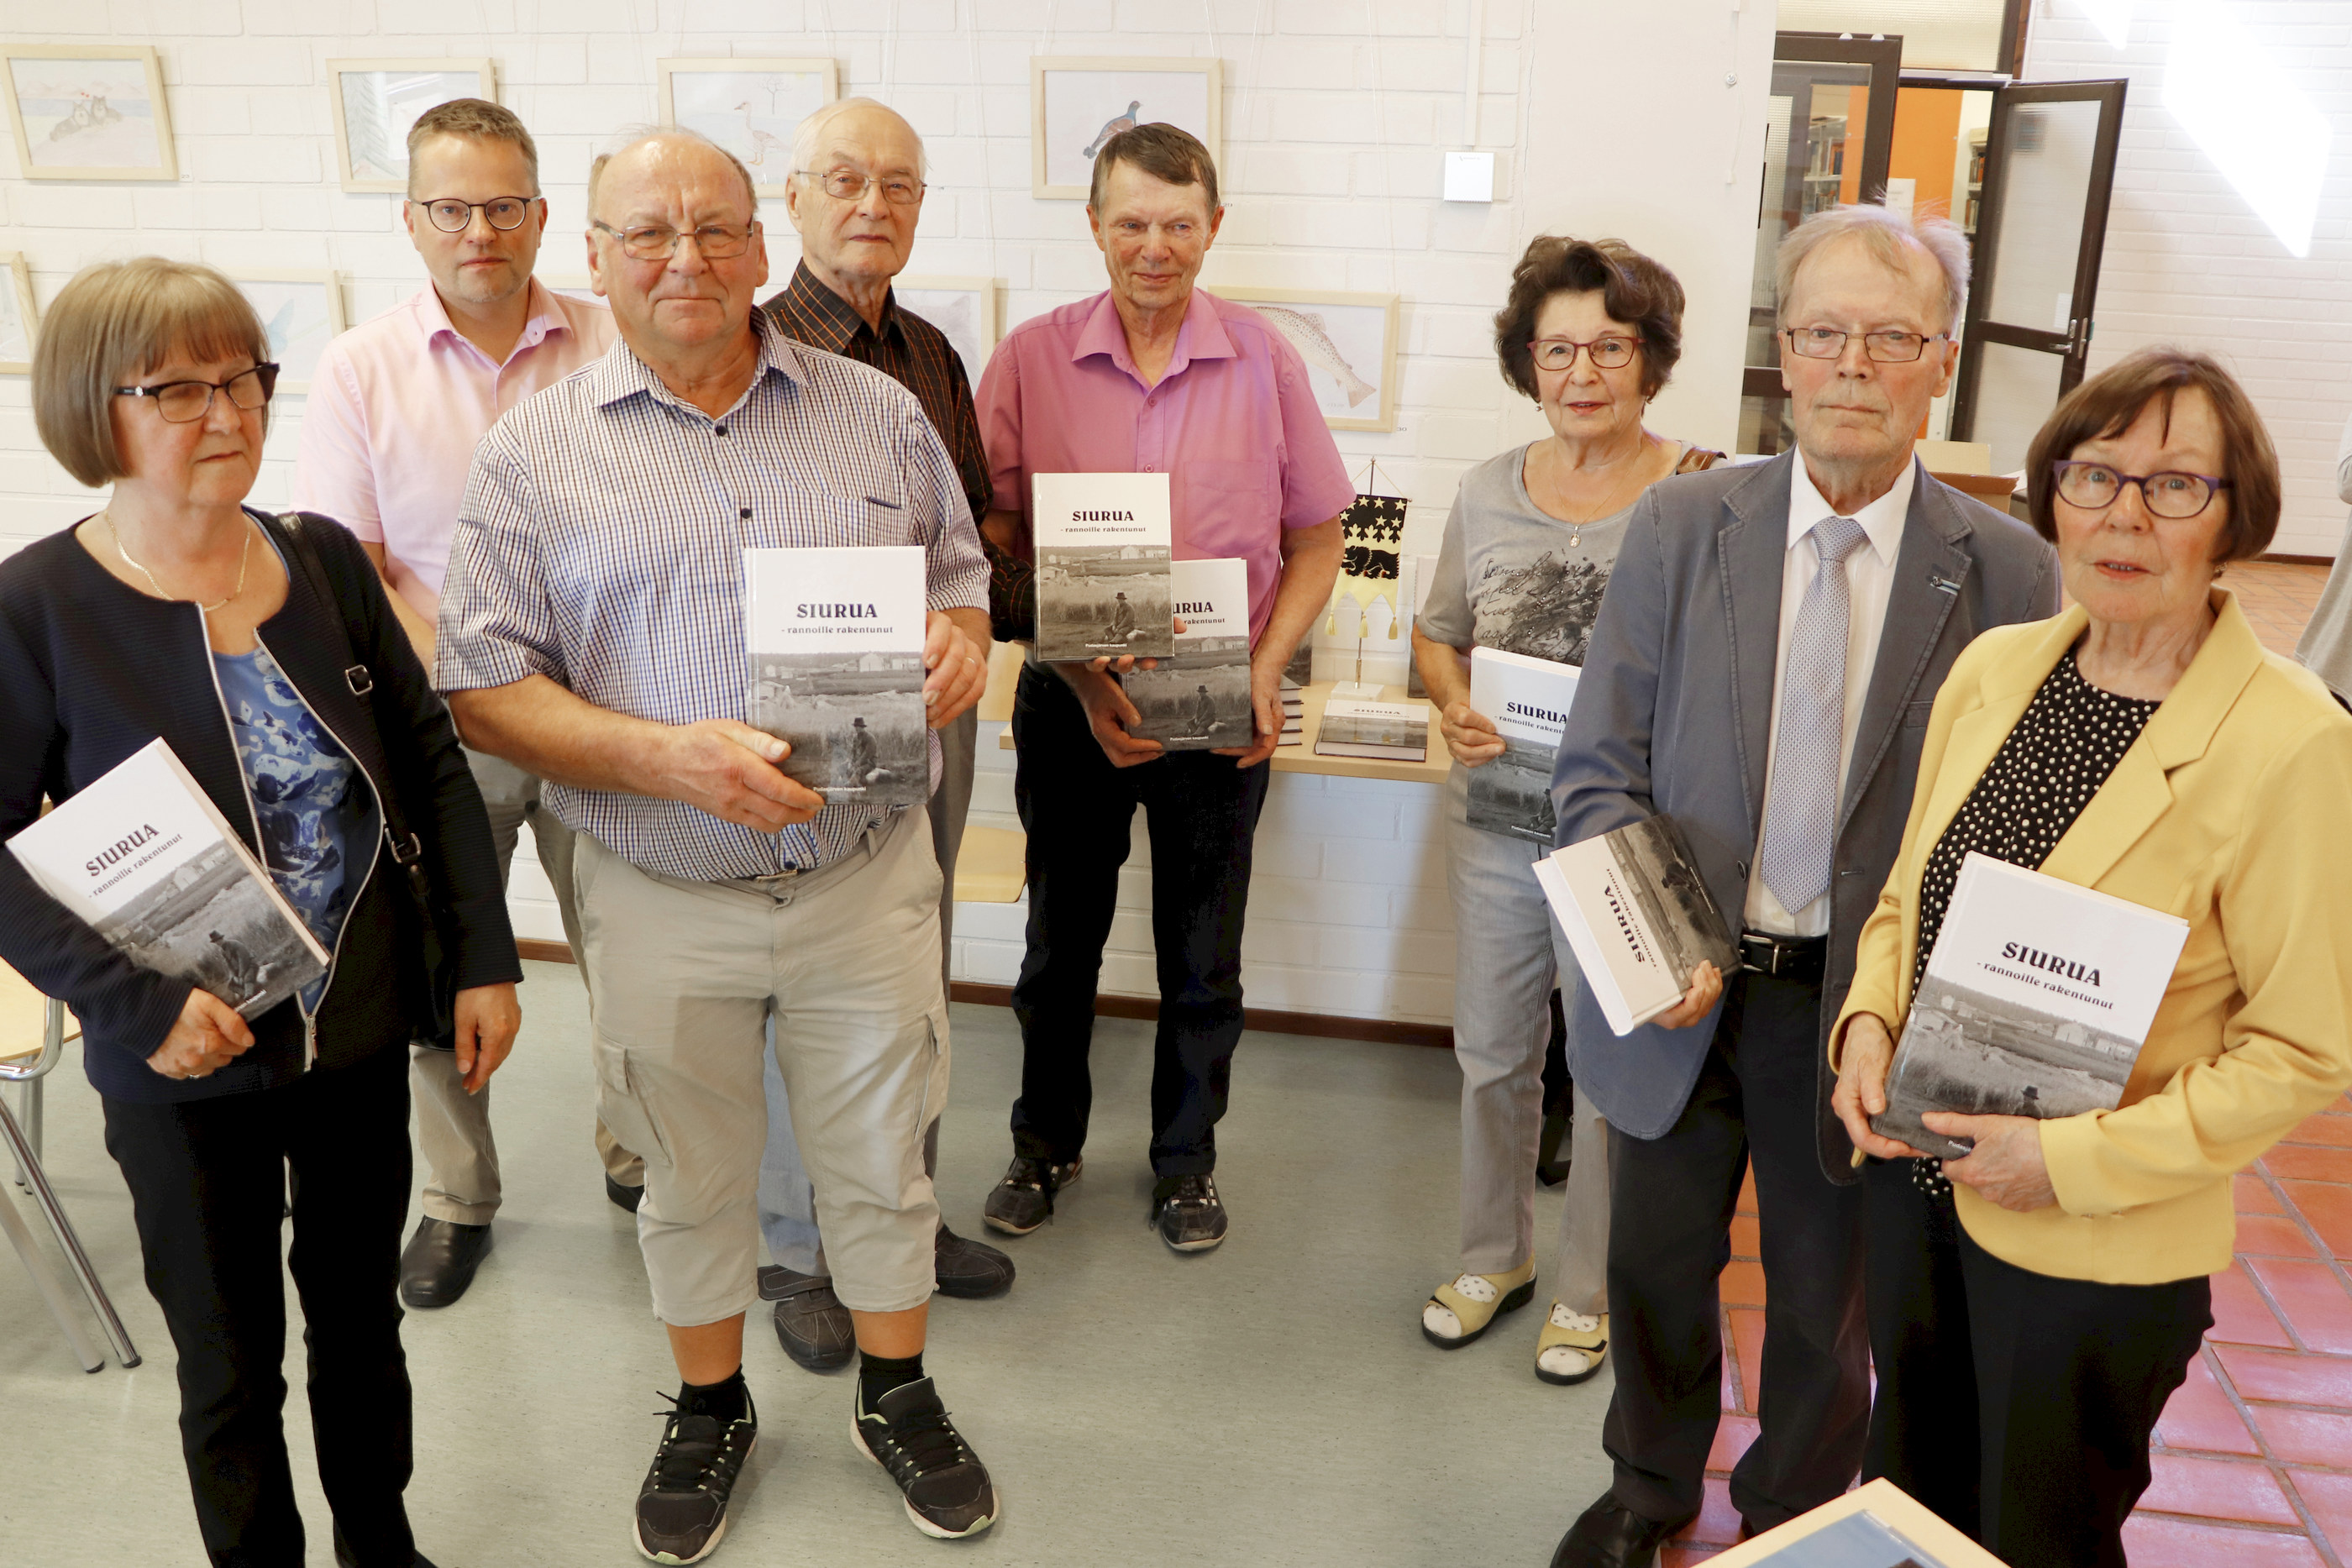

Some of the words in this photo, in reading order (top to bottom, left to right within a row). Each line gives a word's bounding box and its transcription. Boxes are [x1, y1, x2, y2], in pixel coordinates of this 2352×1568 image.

[1072, 511, 1134, 522] SIURUA
[796, 603, 878, 618] SIURUA
[1173, 601, 1214, 614] URUA
[787, 626, 834, 634] rannoille
[837, 626, 893, 634] rakentunut
[1506, 701, 1567, 725] SIURUA
[1499, 716, 1535, 729] rannoille
[1536, 725, 1564, 735] rakent
[86, 823, 160, 877] SIURUA
[92, 867, 134, 896] rannoille
[133, 833, 183, 869] rakentunut
[1604, 884, 1646, 963] SIURUA
[2001, 941, 2102, 988] SIURUA
[1983, 962, 2041, 987] rannoille
[2043, 981, 2114, 1010] rakentunut
